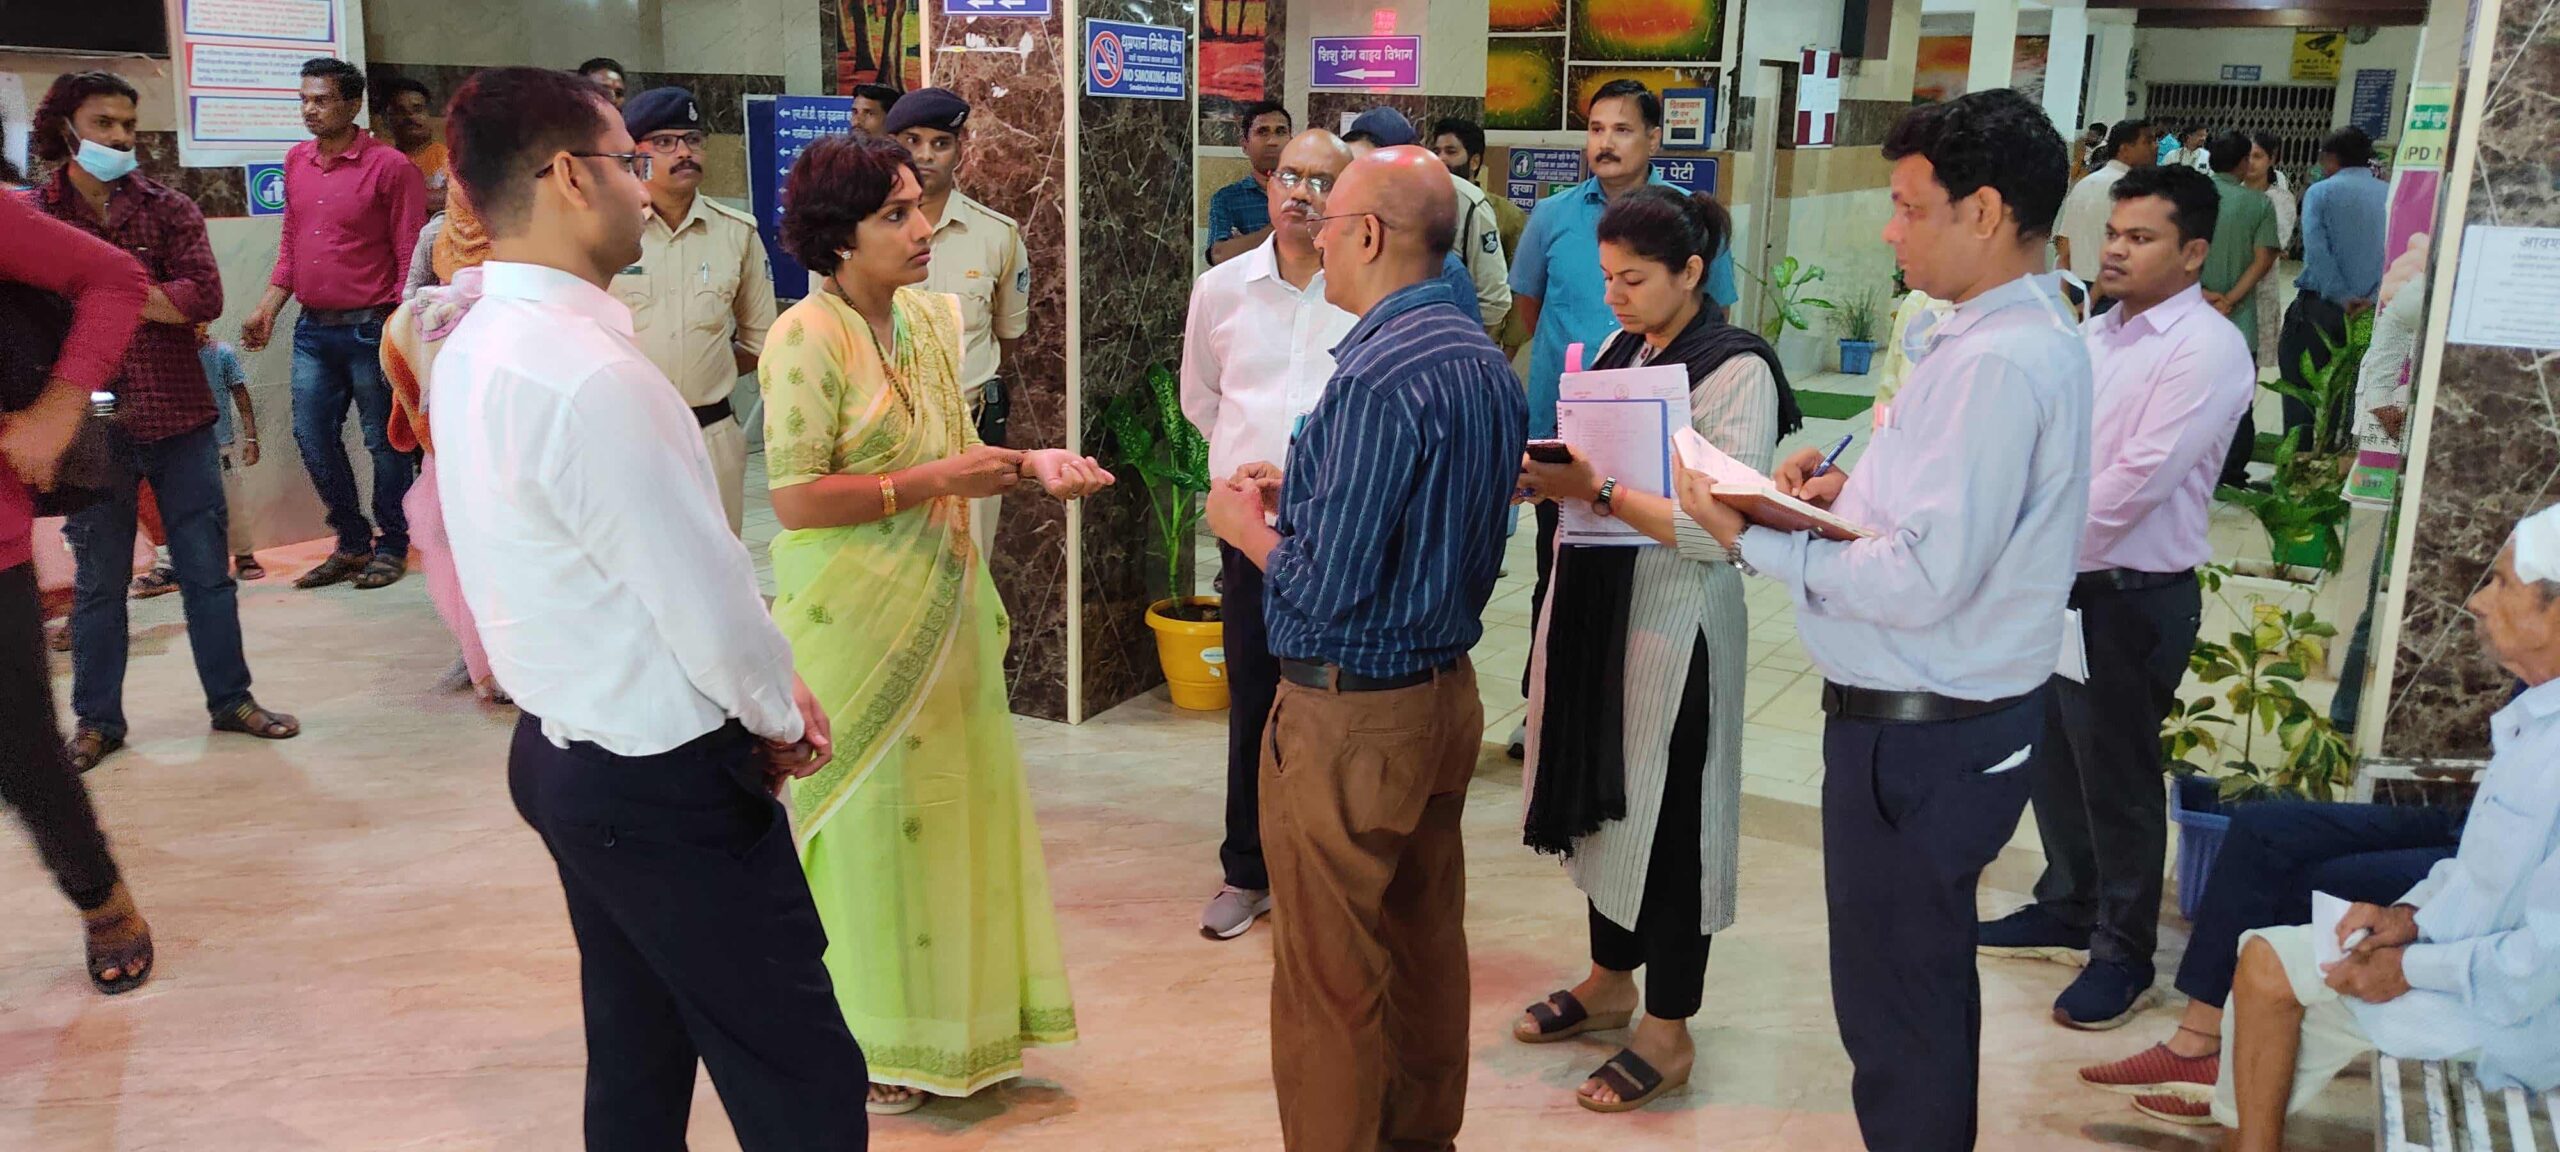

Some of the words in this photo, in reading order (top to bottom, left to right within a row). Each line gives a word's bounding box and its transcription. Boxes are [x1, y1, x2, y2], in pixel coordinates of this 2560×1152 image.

[1149, 32, 1169, 52] निषेध
[1318, 45, 1338, 66] शिशु
[1341, 45, 1356, 61] रोग
[1384, 44, 1413, 61] विभाग
[1123, 68, 1134, 81] NO
[1134, 69, 1165, 83] SMOKING
[1165, 71, 1182, 84] AREA
[2404, 146, 2430, 161] PD
[1670, 161, 1695, 180] पेटी
[1511, 183, 1534, 196] सूखा
